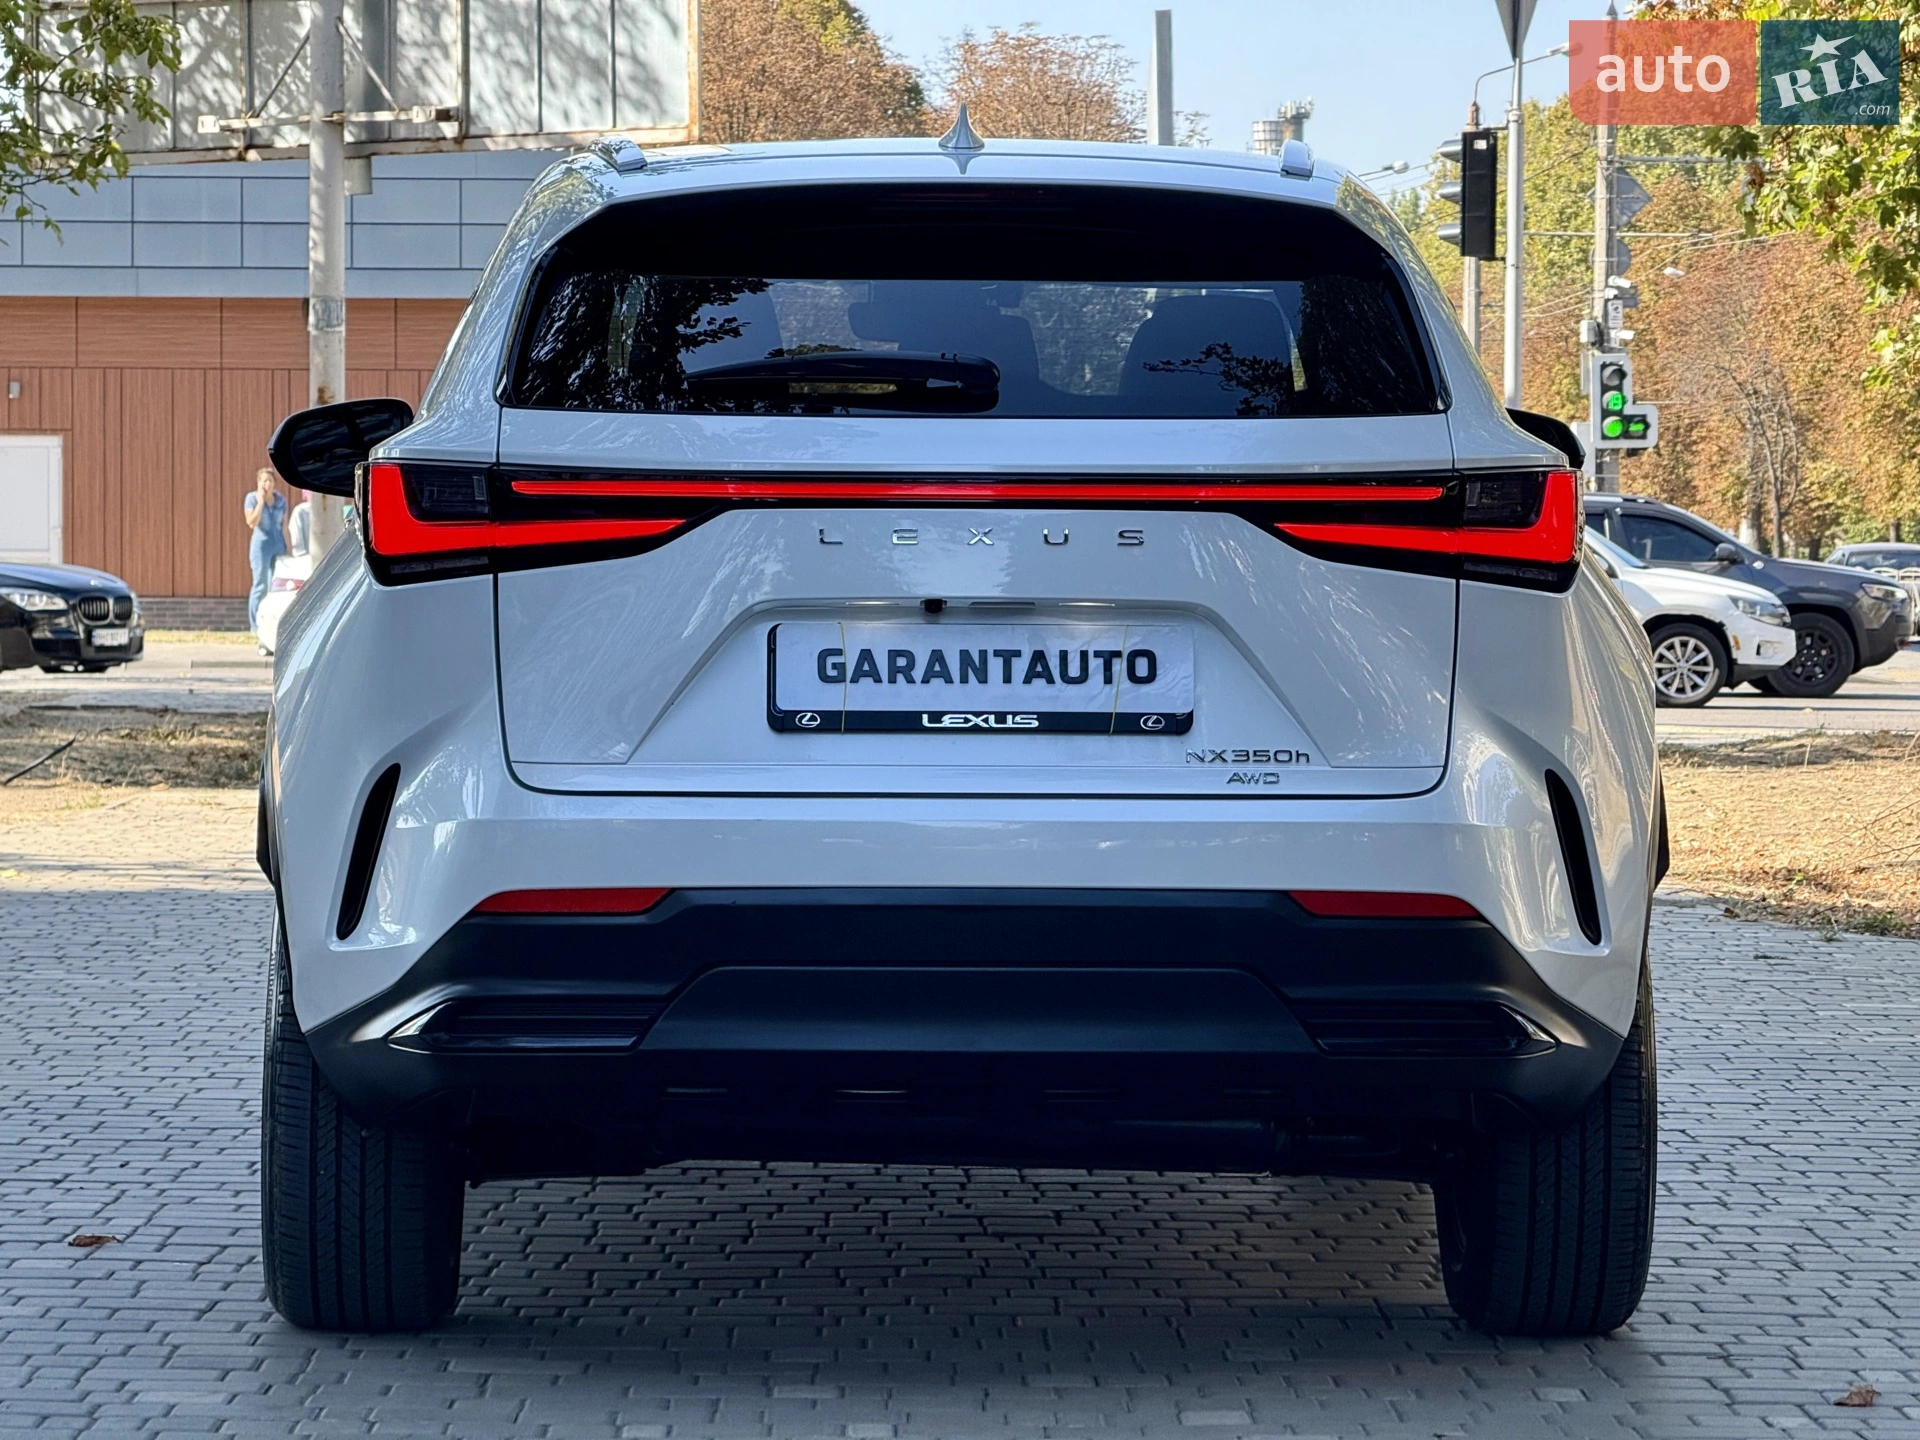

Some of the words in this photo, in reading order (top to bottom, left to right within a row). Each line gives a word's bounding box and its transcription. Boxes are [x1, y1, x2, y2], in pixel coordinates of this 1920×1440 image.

[818, 527, 1144, 546] LEXUS
[817, 648, 1158, 685] GARANTAUTO
[921, 714, 1039, 728] LEXUS
[1185, 748, 1310, 764] NX350h
[1226, 772, 1280, 785] AWD
